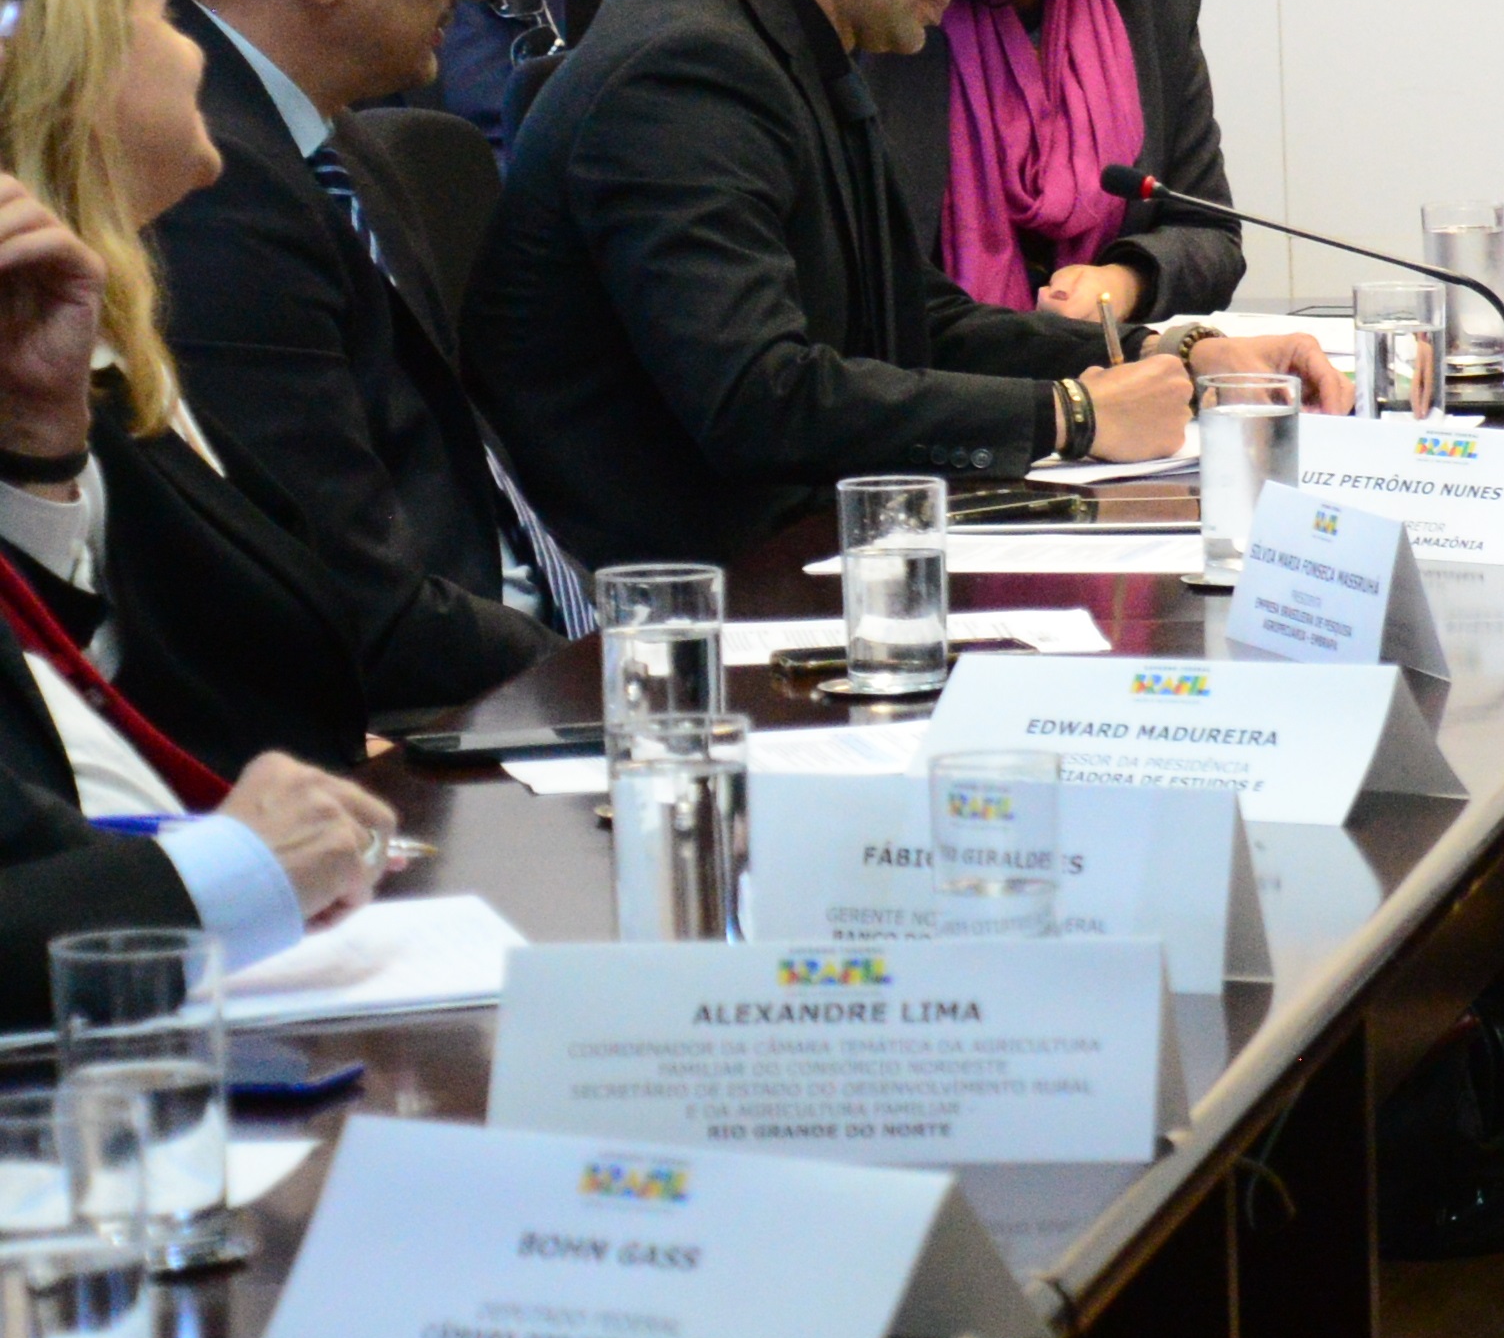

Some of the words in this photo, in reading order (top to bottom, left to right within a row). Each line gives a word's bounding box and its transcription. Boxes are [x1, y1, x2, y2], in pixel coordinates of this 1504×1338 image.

[1414, 437, 1478, 459] BRASIL
[1301, 471, 1335, 487] UIZ
[1339, 470, 1435, 495] PETRÔNIO
[1440, 482, 1502, 501] NUNES
[1411, 534, 1484, 551] AMAZÔNIA
[1130, 673, 1211, 696] BRASIL
[1026, 718, 1128, 739] EDWARD
[1136, 724, 1279, 747] MADUREIRA
[1143, 754, 1251, 773] PRESIDÊNCIA
[1253, 781, 1264, 792] E
[693, 1003, 888, 1026] ALEXANDRE
[901, 1002, 983, 1024] LIMA
[707, 1123, 743, 1140] RIO
[751, 1122, 839, 1140] GRANDE
[845, 1122, 875, 1140] DO
[882, 1122, 952, 1139] NORTE
[517, 1231, 609, 1261] BOHN
[617, 1239, 702, 1270] GASS
